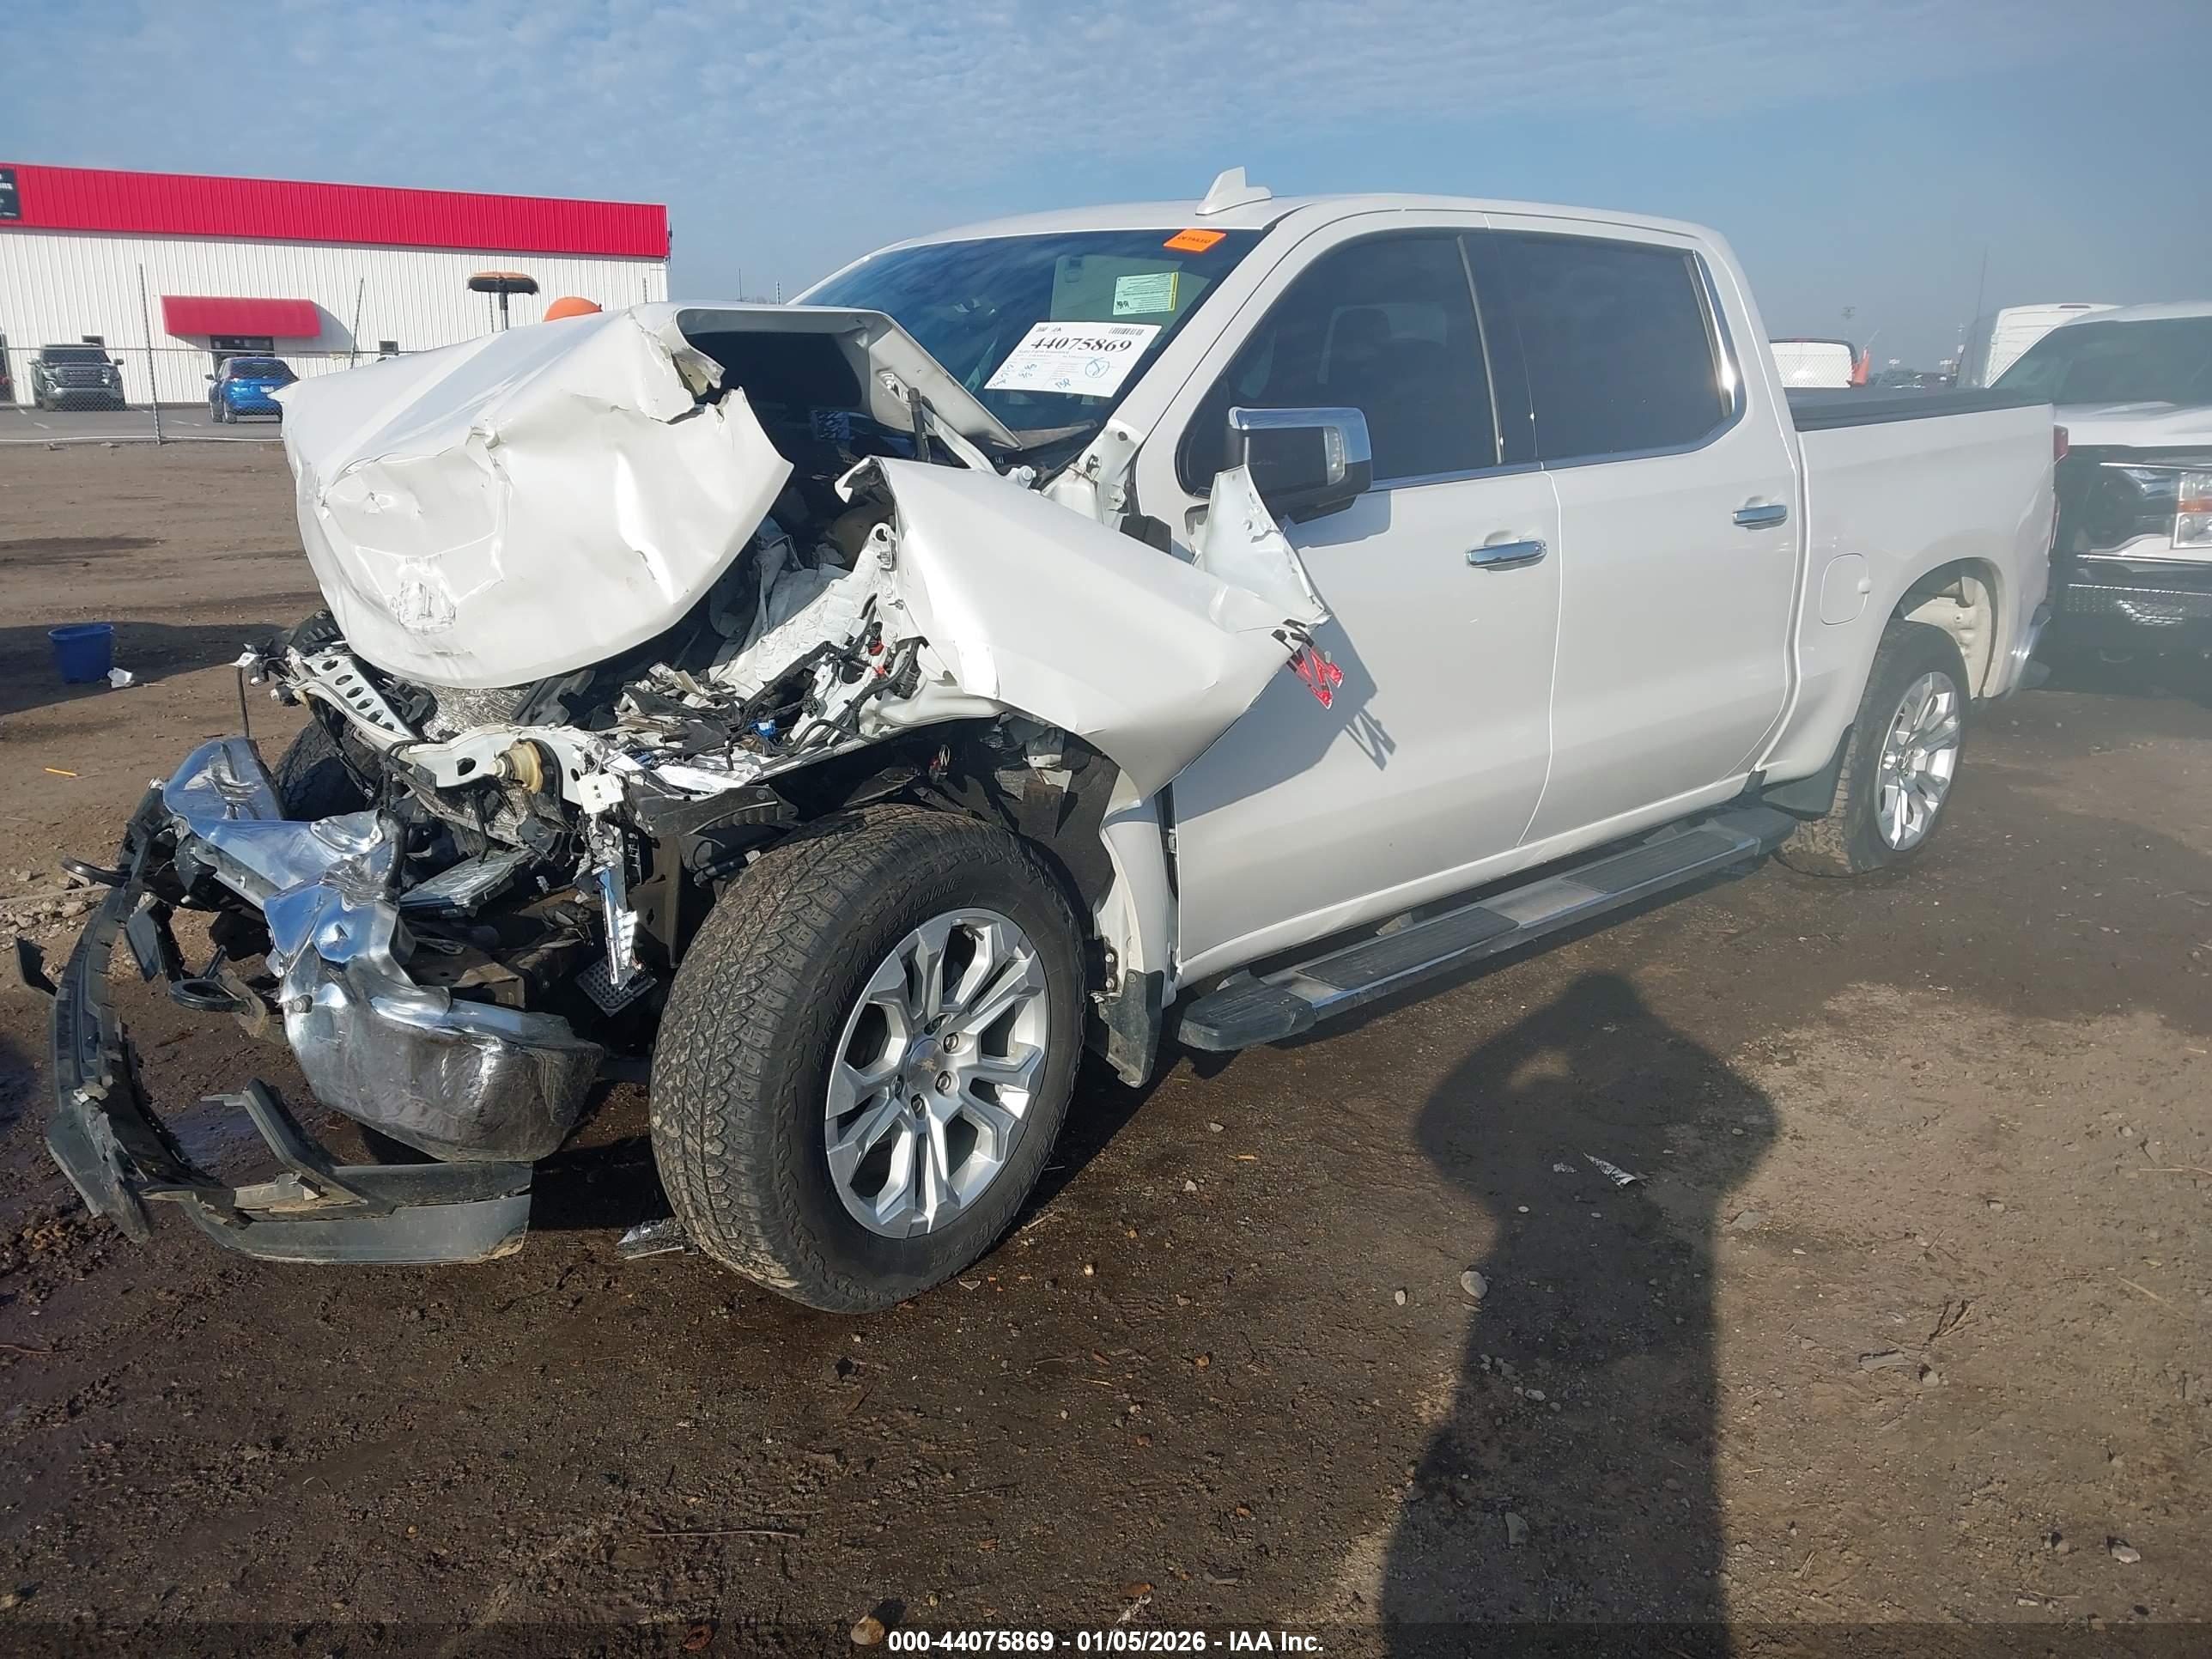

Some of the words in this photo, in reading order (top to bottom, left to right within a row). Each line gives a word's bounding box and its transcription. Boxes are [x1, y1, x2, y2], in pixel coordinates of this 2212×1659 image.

[1031, 337, 1132, 352] 44075869
[812, 876, 963, 1072] BRIDGESTONE
[970, 1103, 1062, 1249] DUELER
